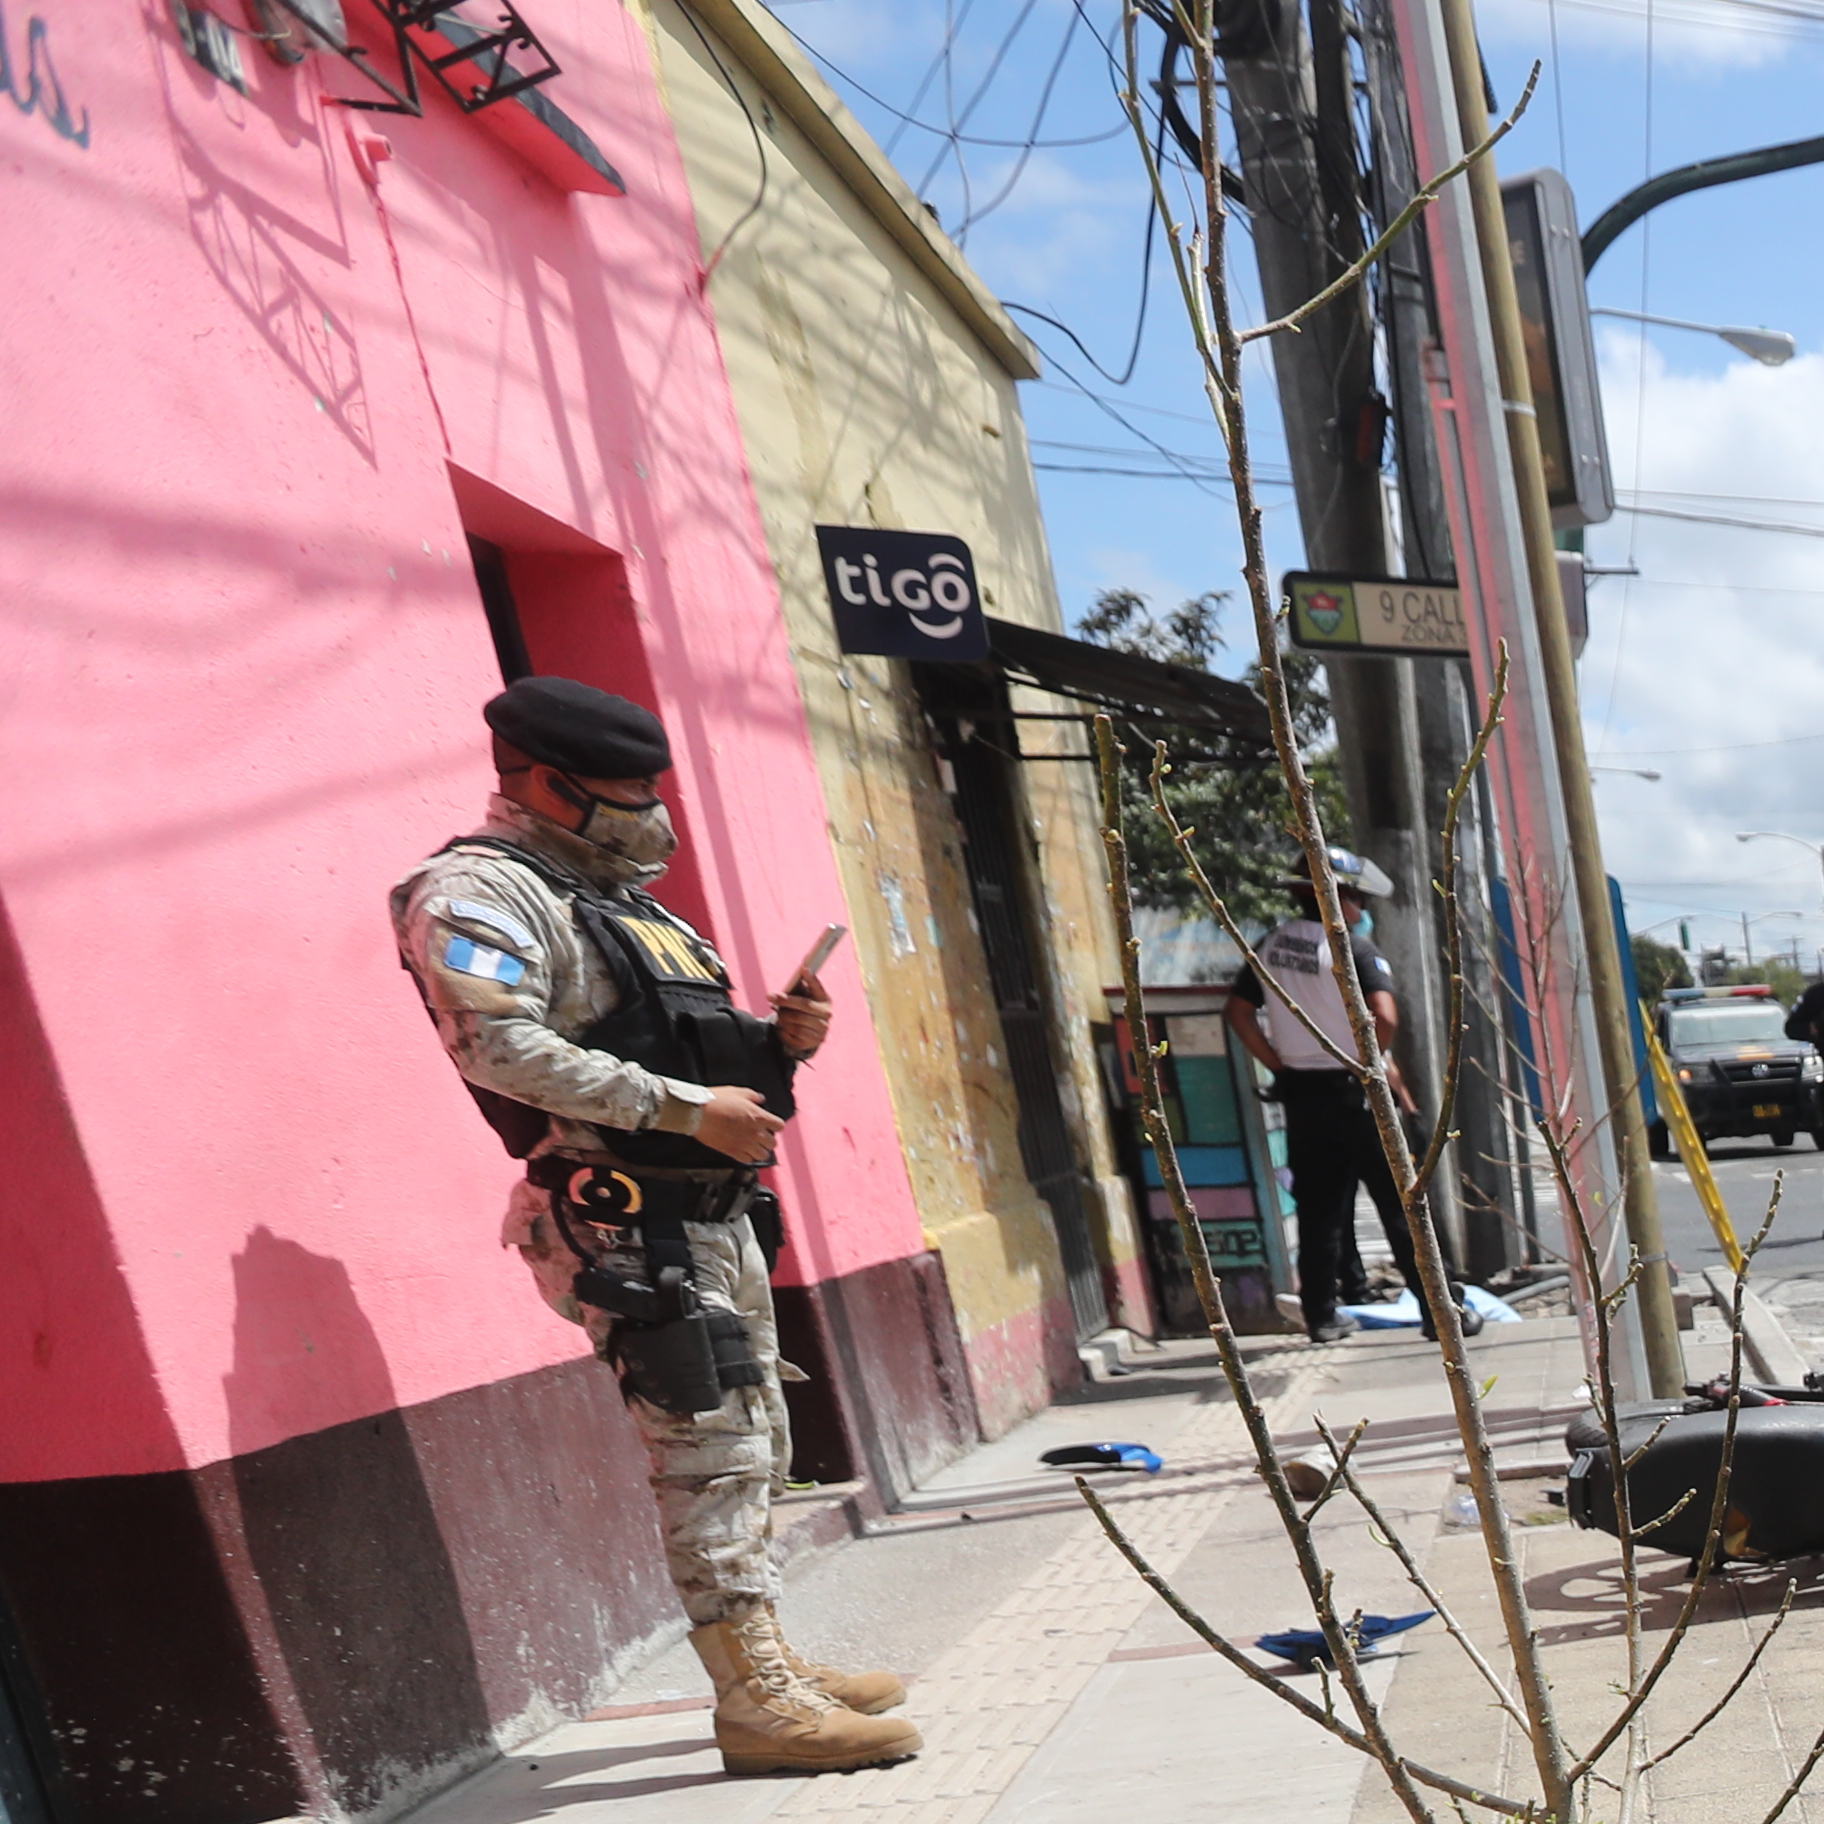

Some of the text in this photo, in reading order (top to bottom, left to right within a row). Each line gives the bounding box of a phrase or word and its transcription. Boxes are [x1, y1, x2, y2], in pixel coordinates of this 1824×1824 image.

[834, 552, 971, 613] tigo
[1379, 590, 1464, 625] 9 CALL
[1401, 624, 1456, 642] ZONA
